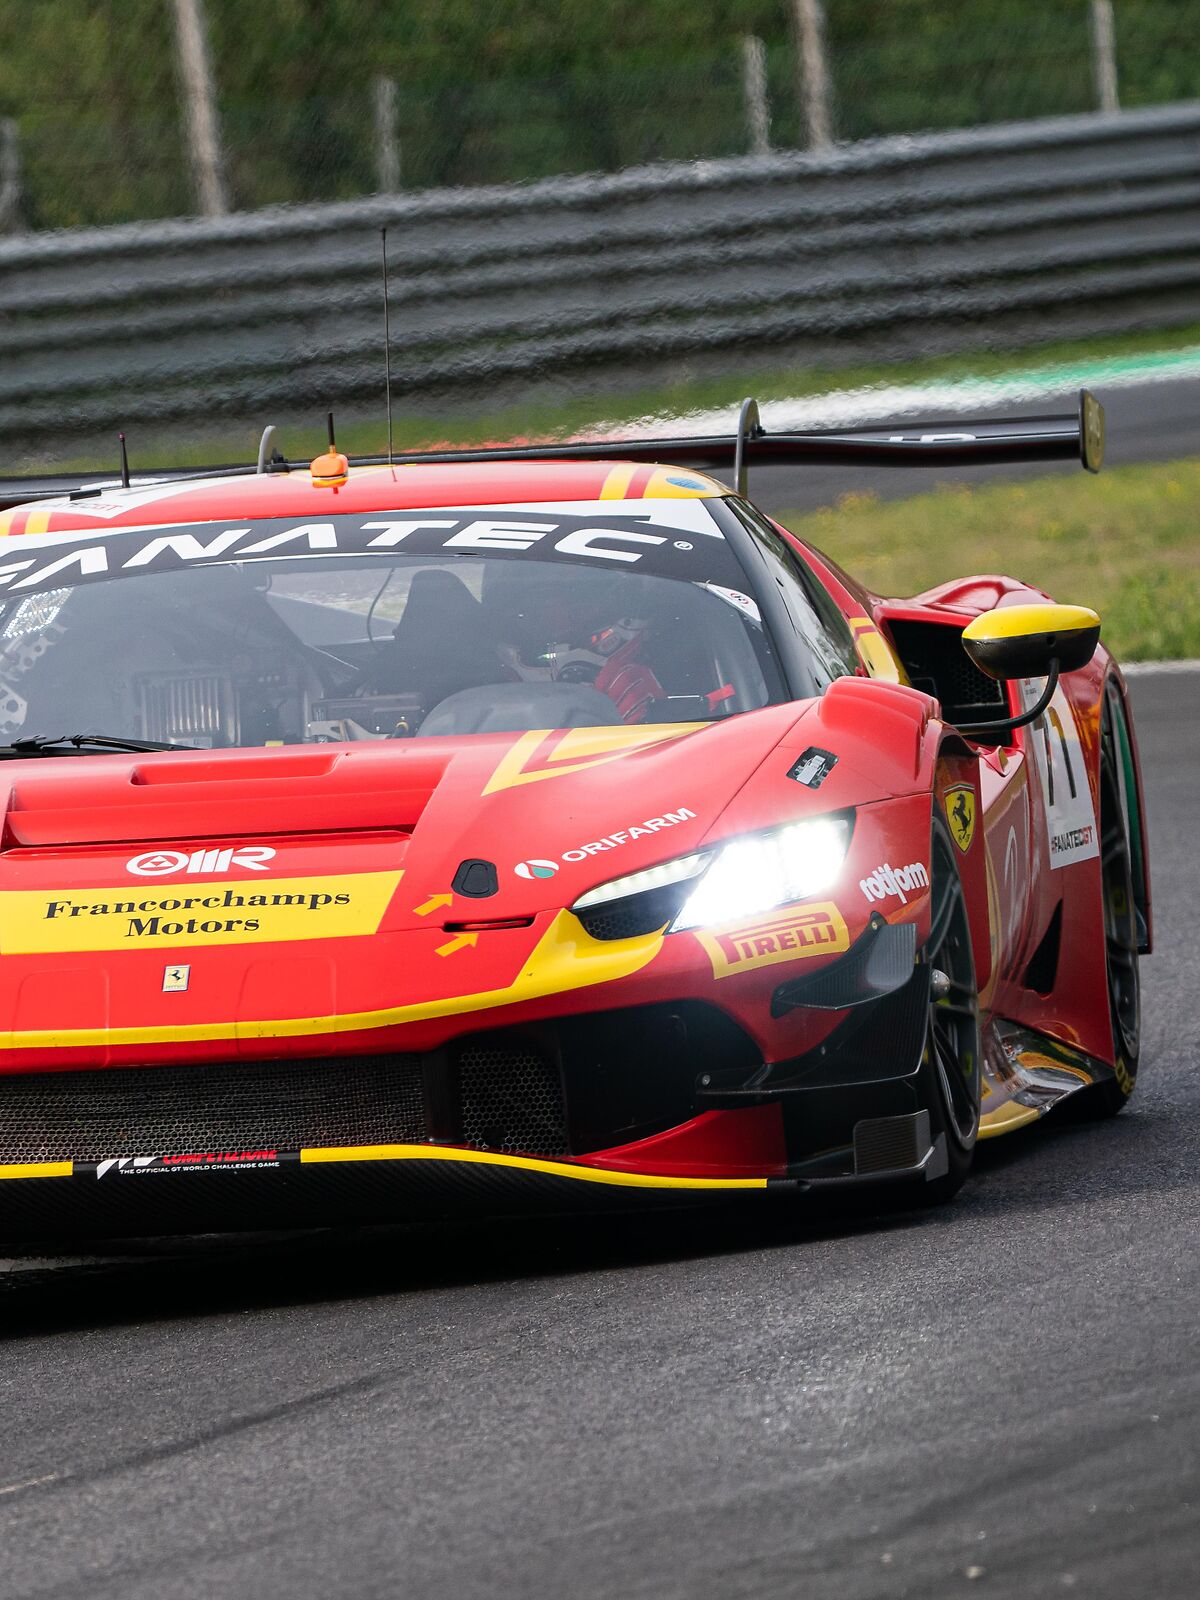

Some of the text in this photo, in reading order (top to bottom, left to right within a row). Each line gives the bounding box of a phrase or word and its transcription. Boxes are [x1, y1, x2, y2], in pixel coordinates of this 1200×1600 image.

[562, 808, 697, 862] ORIFARM
[859, 862, 930, 904] rotiform
[42, 890, 351, 919] Francorchamps
[124, 915, 260, 937] Motors
[715, 912, 837, 965] PIRELLI
